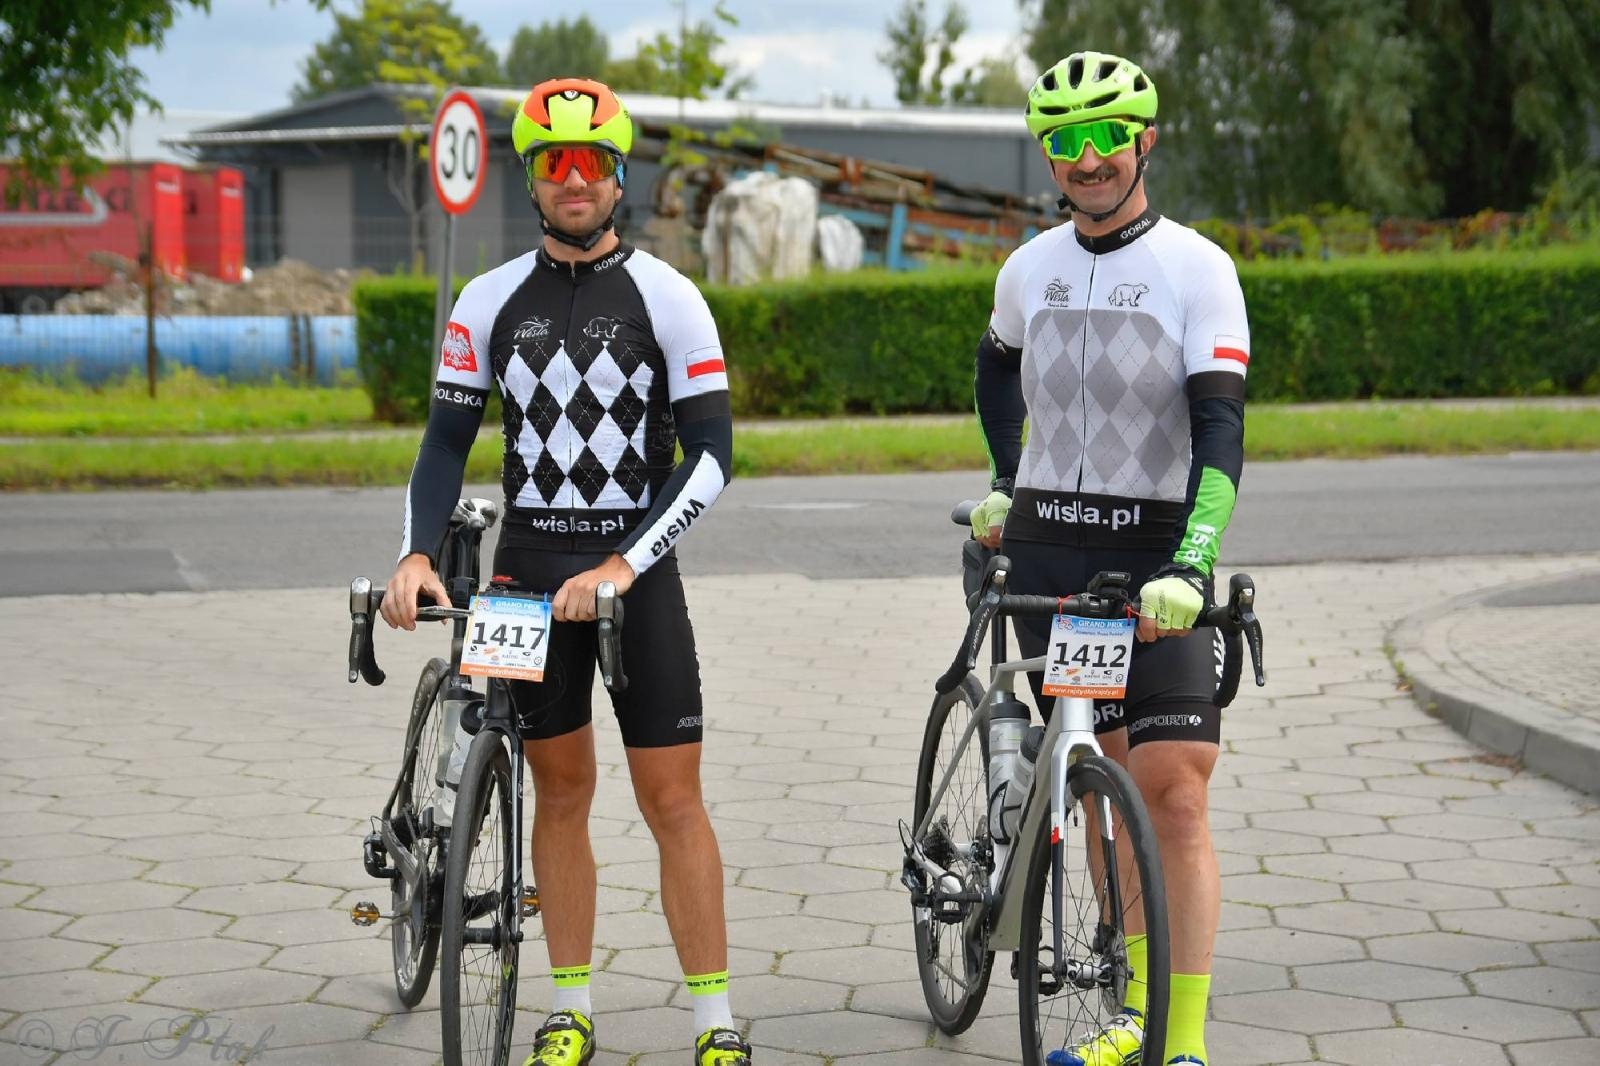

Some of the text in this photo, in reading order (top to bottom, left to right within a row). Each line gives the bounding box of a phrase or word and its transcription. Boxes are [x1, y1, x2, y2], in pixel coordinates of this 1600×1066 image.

[442, 125, 480, 180] 30
[471, 621, 547, 651] 1417
[1078, 619, 1123, 629] GRAND PRIX
[1053, 642, 1128, 668] 1412
